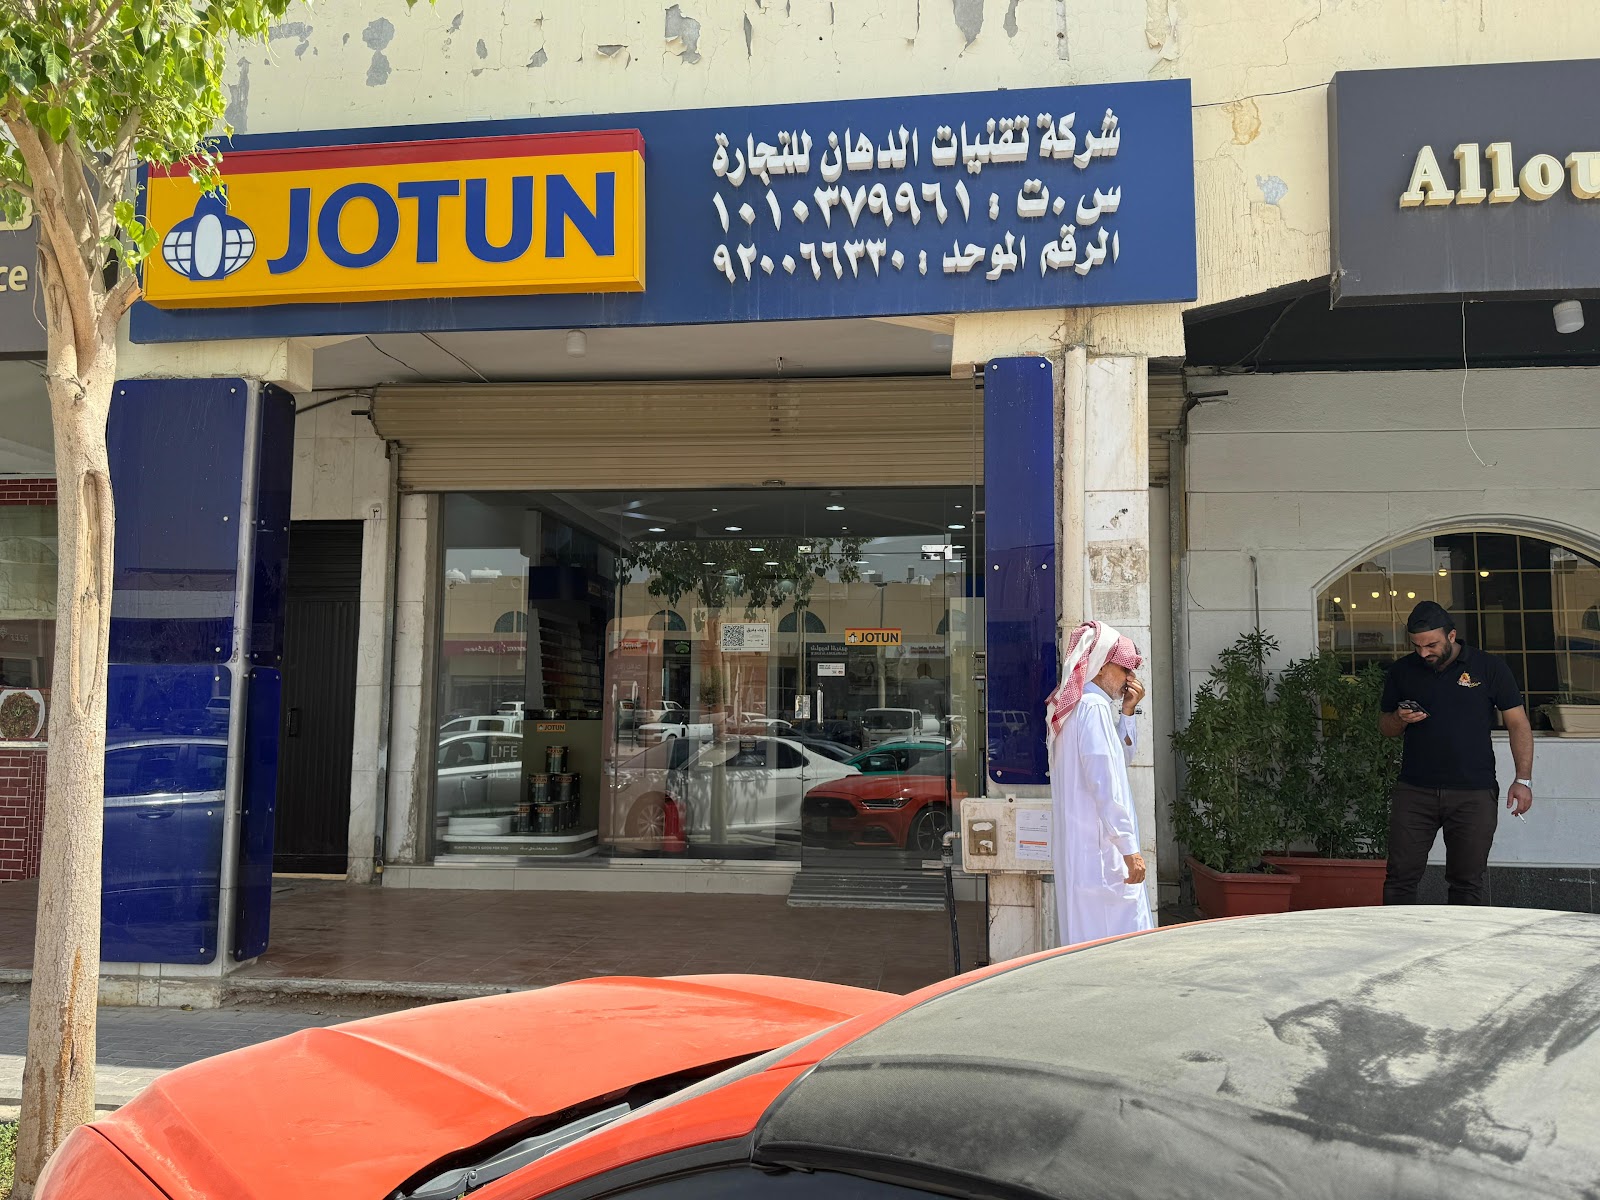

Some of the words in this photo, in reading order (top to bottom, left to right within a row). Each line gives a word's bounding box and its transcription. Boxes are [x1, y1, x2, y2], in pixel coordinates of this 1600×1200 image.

[712, 129, 813, 188] للتجارة
[820, 124, 919, 183] الدهان
[931, 114, 1030, 175] تقنيات
[1036, 107, 1121, 169] شركة
[266, 171, 616, 275] JOTUN
[712, 179, 970, 234] ١٠١٠٣٧٩٩٦١
[713, 238, 905, 284] ٩٢٠٠٦٦٣٣٠
[942, 230, 1026, 281] الموحد
[1039, 223, 1120, 278] الرقم
[859, 632, 899, 643] JOTUN
[490, 745, 518, 758] LIFE
